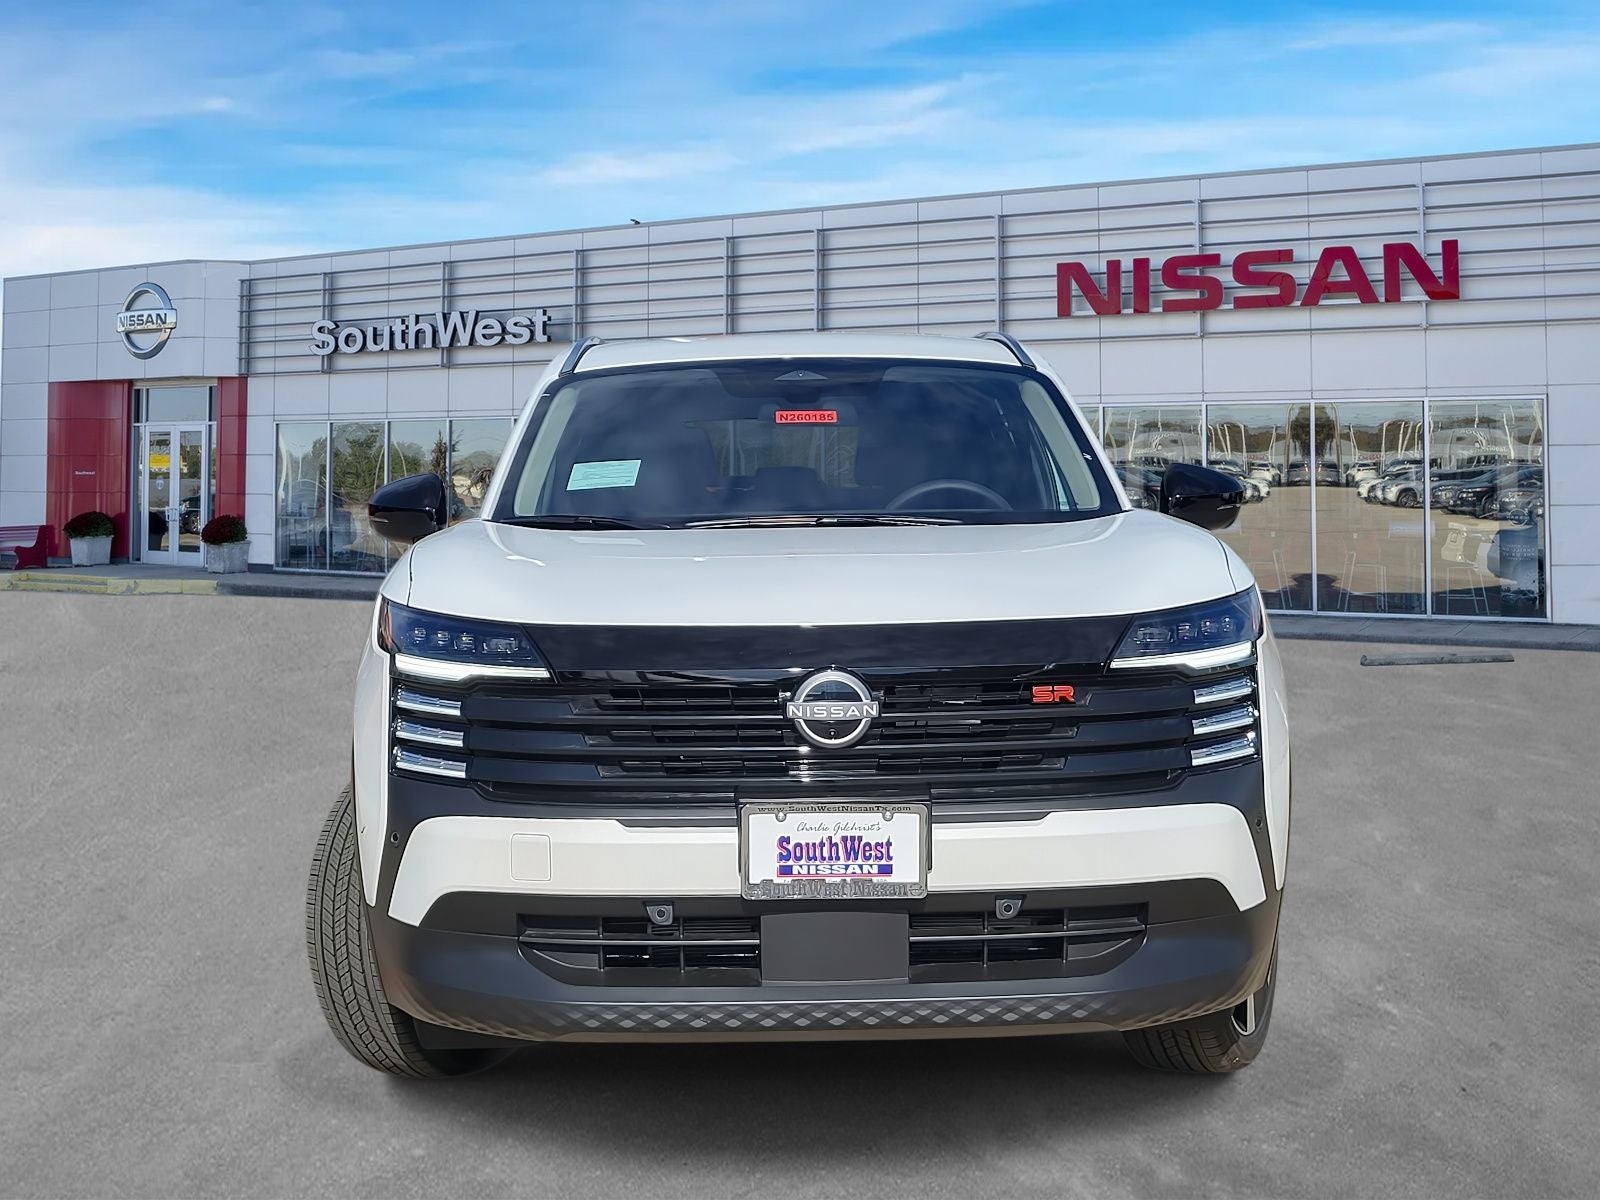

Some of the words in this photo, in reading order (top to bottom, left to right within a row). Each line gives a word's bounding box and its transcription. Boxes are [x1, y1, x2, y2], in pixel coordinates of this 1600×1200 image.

[1056, 238, 1461, 318] NISSAN
[119, 312, 168, 328] NISSAN
[308, 308, 552, 356] SouthWest
[779, 413, 834, 421] N260185
[1031, 685, 1076, 703] SR
[788, 702, 878, 719] NISSAN
[796, 821, 830, 832] Charlie
[777, 835, 893, 863] SouthWest
[792, 864, 879, 874] NISSAN
